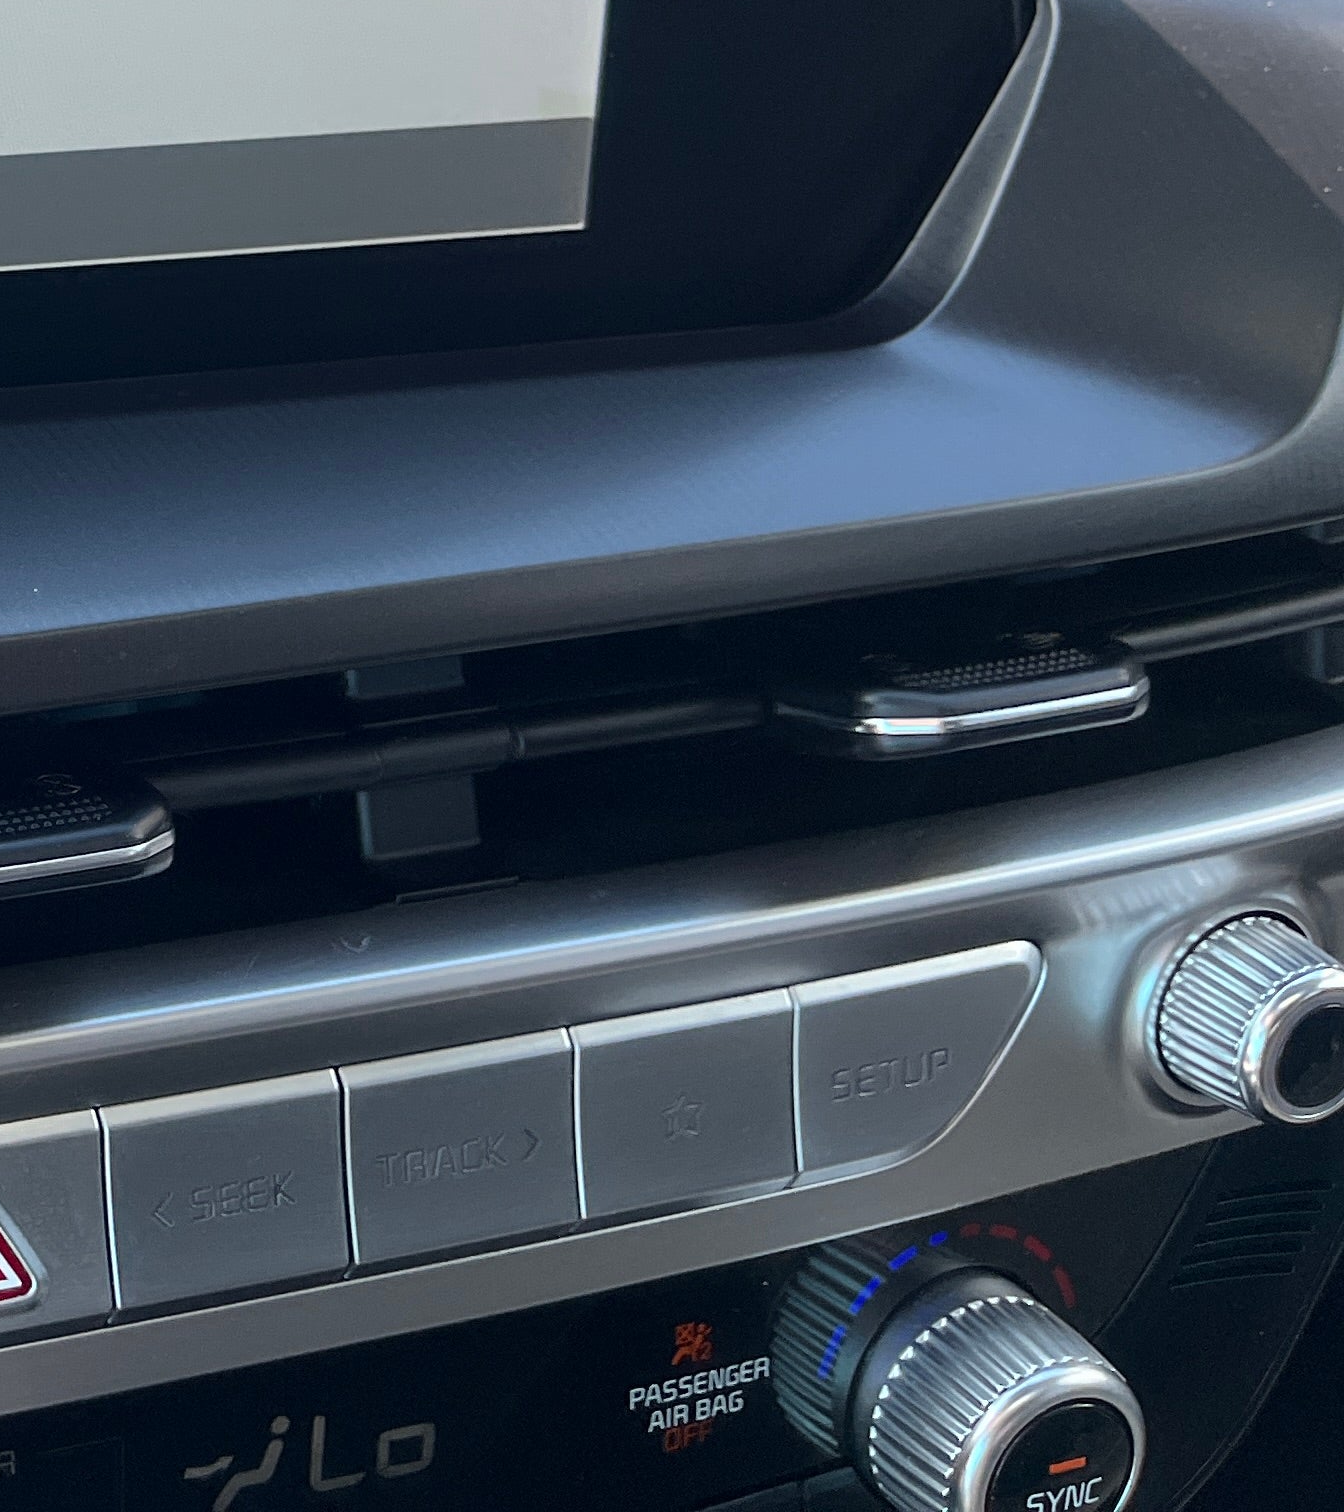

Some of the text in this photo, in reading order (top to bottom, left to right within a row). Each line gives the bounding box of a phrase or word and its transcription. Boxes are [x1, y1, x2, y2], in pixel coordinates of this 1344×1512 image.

[830, 1046, 951, 1105] SETUP
[375, 1130, 510, 1186] TRACK
[190, 1168, 297, 1223] SEEK
[628, 1355, 772, 1411] PASSENGER
[647, 1389, 745, 1434] AIR BAG
[664, 1419, 713, 1453] OFF
[1025, 1476, 1103, 1512] SYNC
